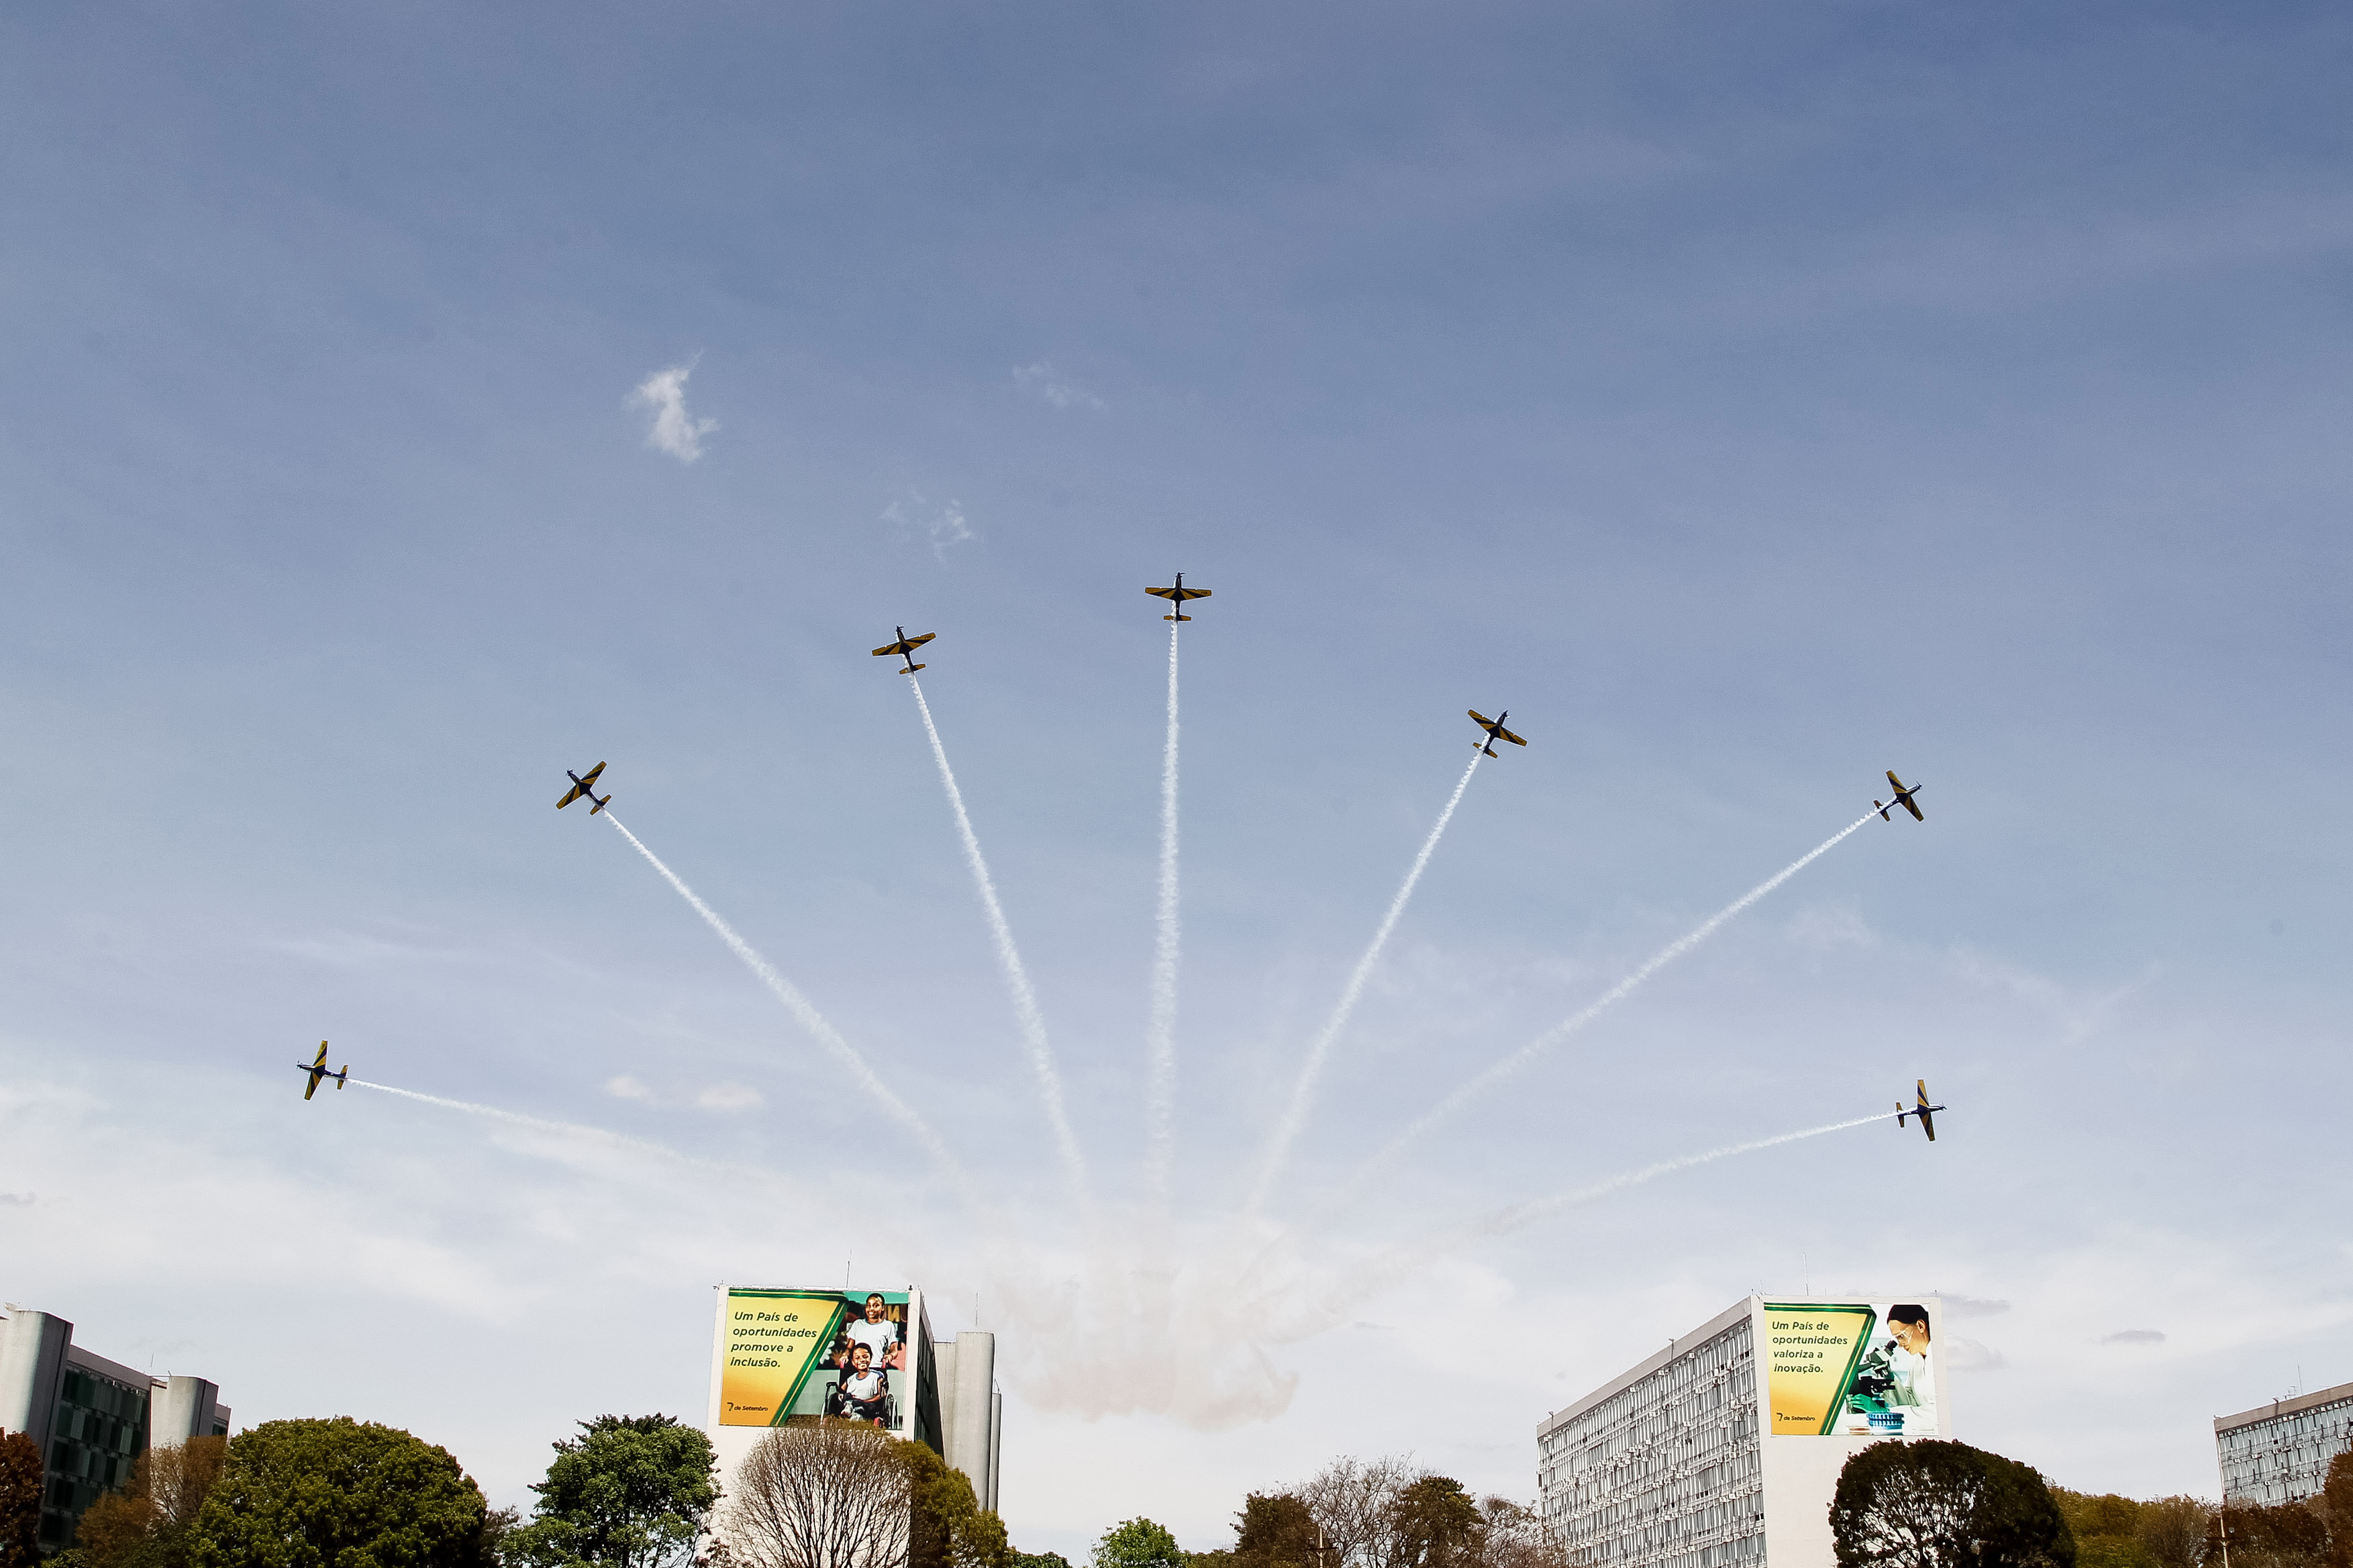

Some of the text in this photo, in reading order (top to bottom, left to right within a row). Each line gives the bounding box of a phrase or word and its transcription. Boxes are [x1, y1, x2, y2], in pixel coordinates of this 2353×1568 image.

[734, 1312, 799, 1322] Um País de
[1772, 1321, 1830, 1330] Um País de
[733, 1328, 817, 1338] oportunidades
[1772, 1336, 1848, 1345] oportunidades
[731, 1343, 783, 1353] promove
[1773, 1349, 1814, 1358] valoriza
[730, 1357, 781, 1367] inclusão.
[1774, 1363, 1823, 1374] inovação.
[727, 1402, 734, 1412] 7
[1776, 1412, 1783, 1422] 7
